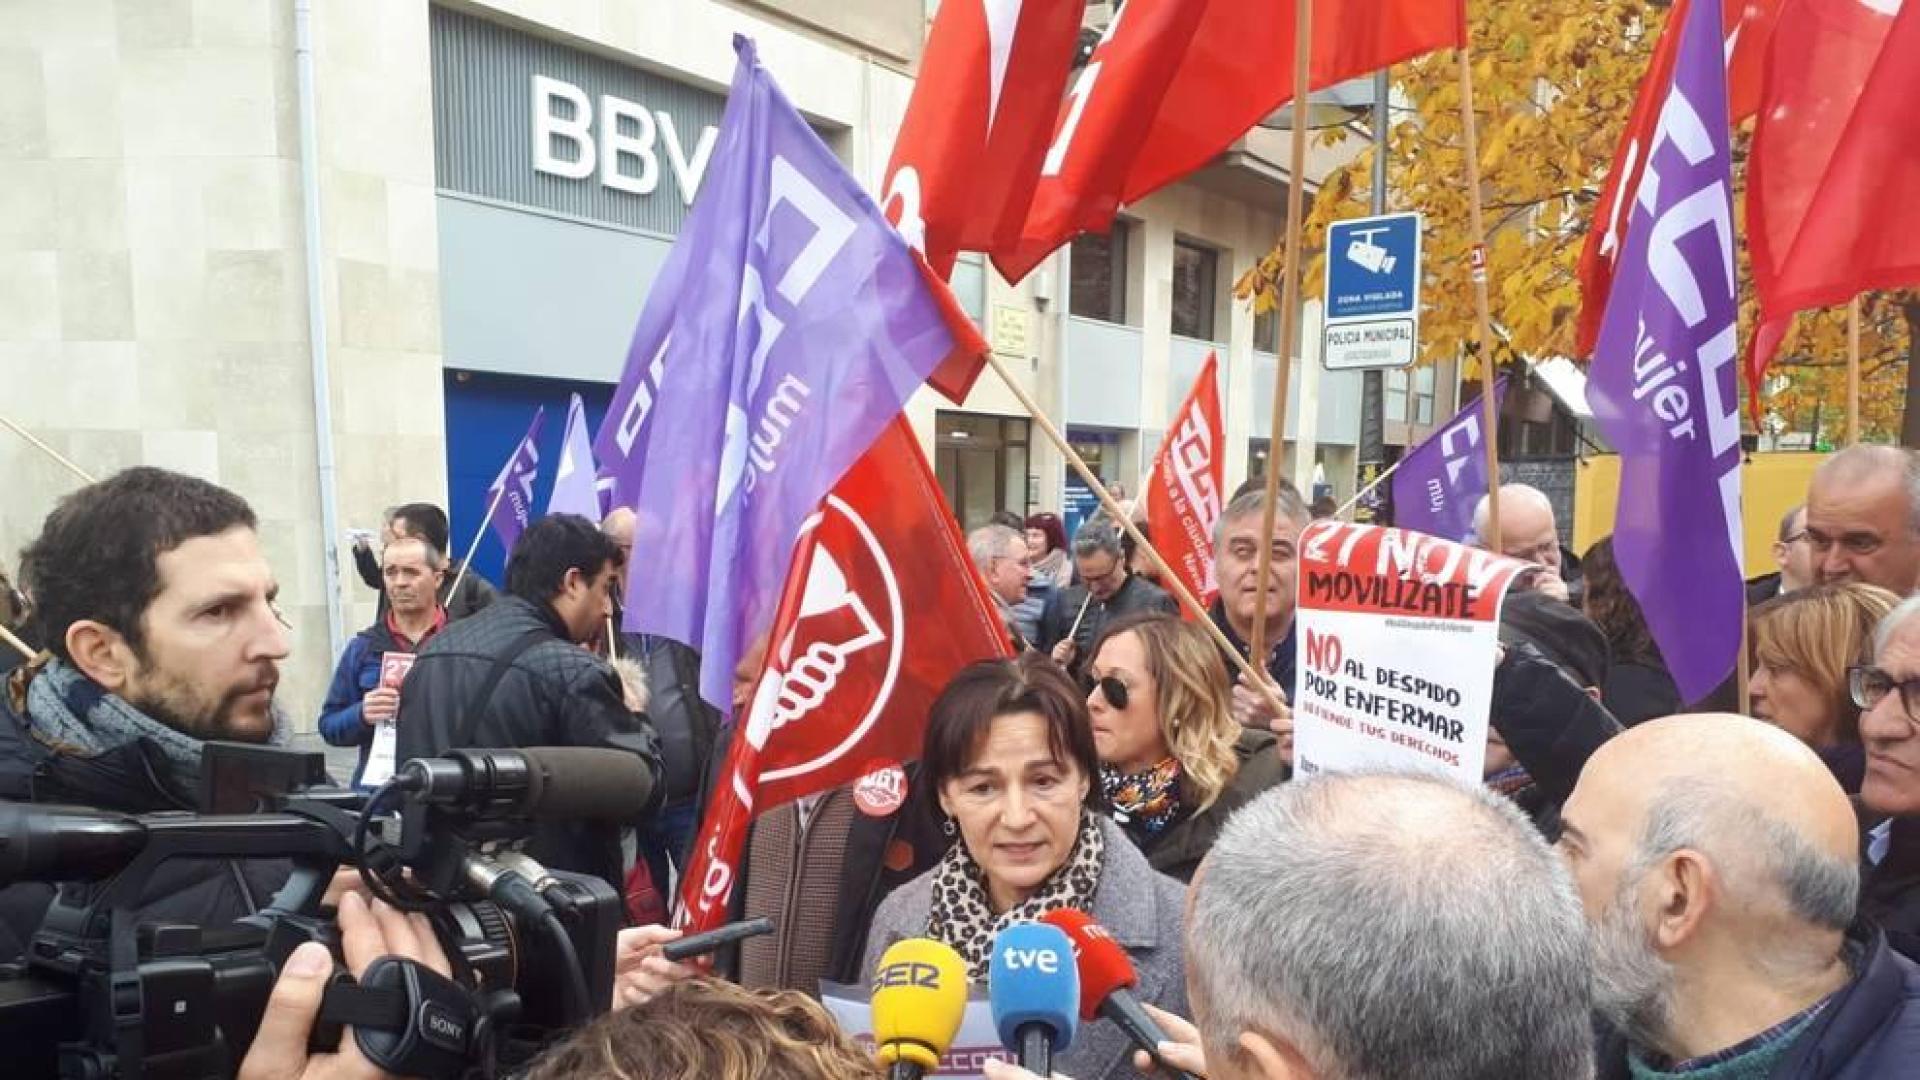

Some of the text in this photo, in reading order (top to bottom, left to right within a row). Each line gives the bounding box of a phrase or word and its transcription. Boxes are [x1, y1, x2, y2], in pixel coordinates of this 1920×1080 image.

[1363, 326, 1410, 342] MUNICIPAL
[1633, 310, 1696, 441] ujer
[1303, 522, 1522, 600] 27 NOV
[1308, 569, 1478, 618] MOVILÍZATE
[1306, 628, 1461, 707] NO AL DESPIDO
[1304, 670, 1465, 743] POR ENFERMAR
[1390, 730, 1460, 767] DERECHOS
[1003, 946, 1059, 974] tve
[430, 1016, 463, 1039] SONY
